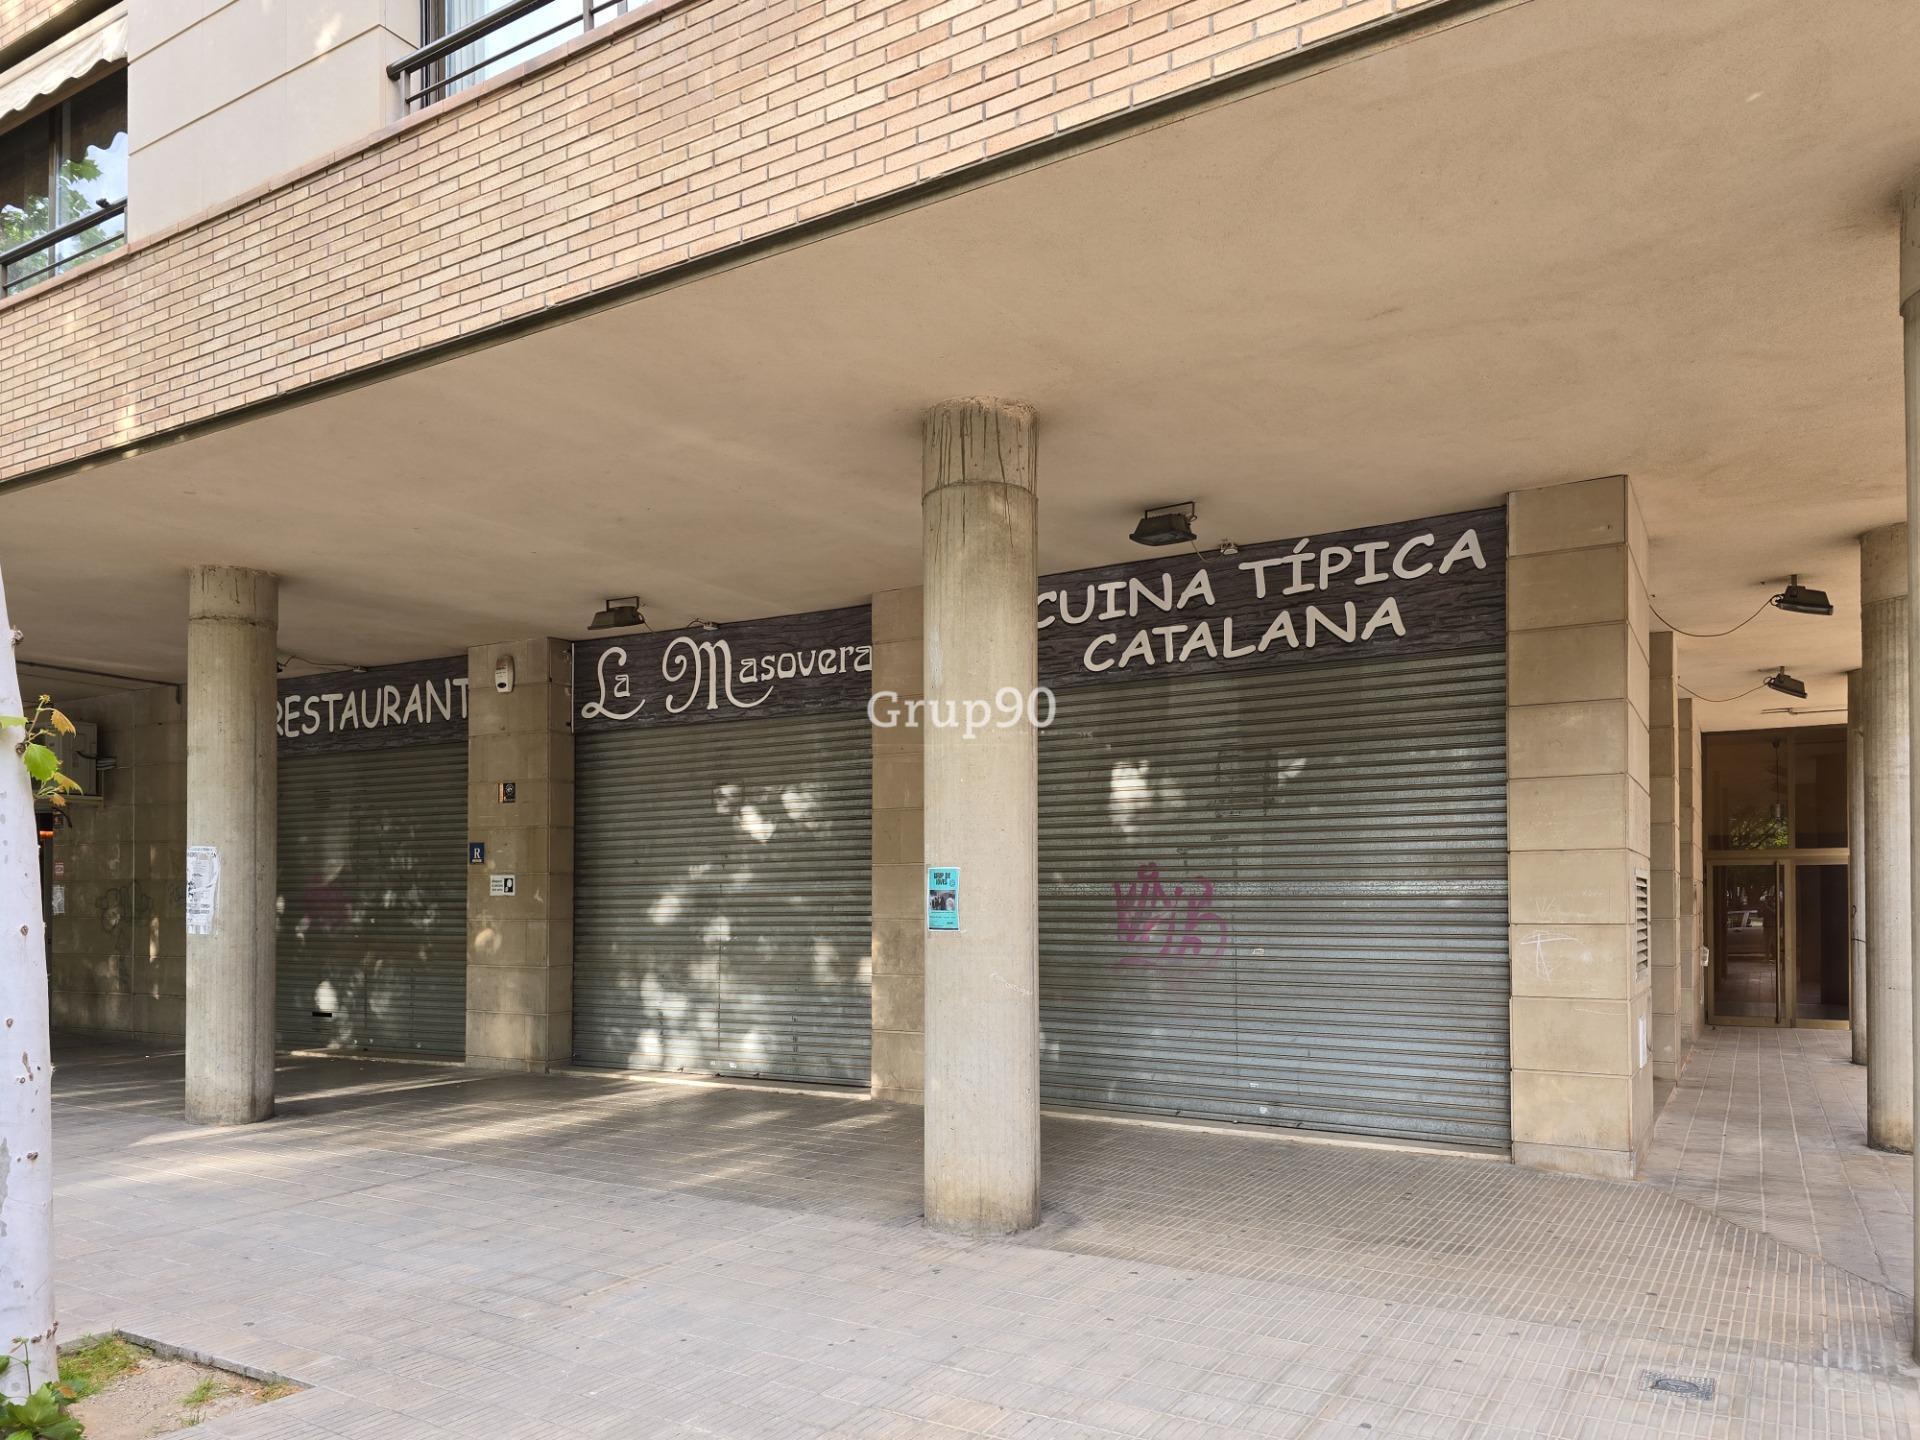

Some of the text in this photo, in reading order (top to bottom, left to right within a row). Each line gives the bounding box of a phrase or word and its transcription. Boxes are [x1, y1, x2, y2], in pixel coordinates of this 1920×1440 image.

[1238, 528, 1488, 600] TÍPICA
[1083, 596, 1407, 673] CATALANA
[580, 636, 873, 721] La Masovera
[473, 847, 481, 859] R
